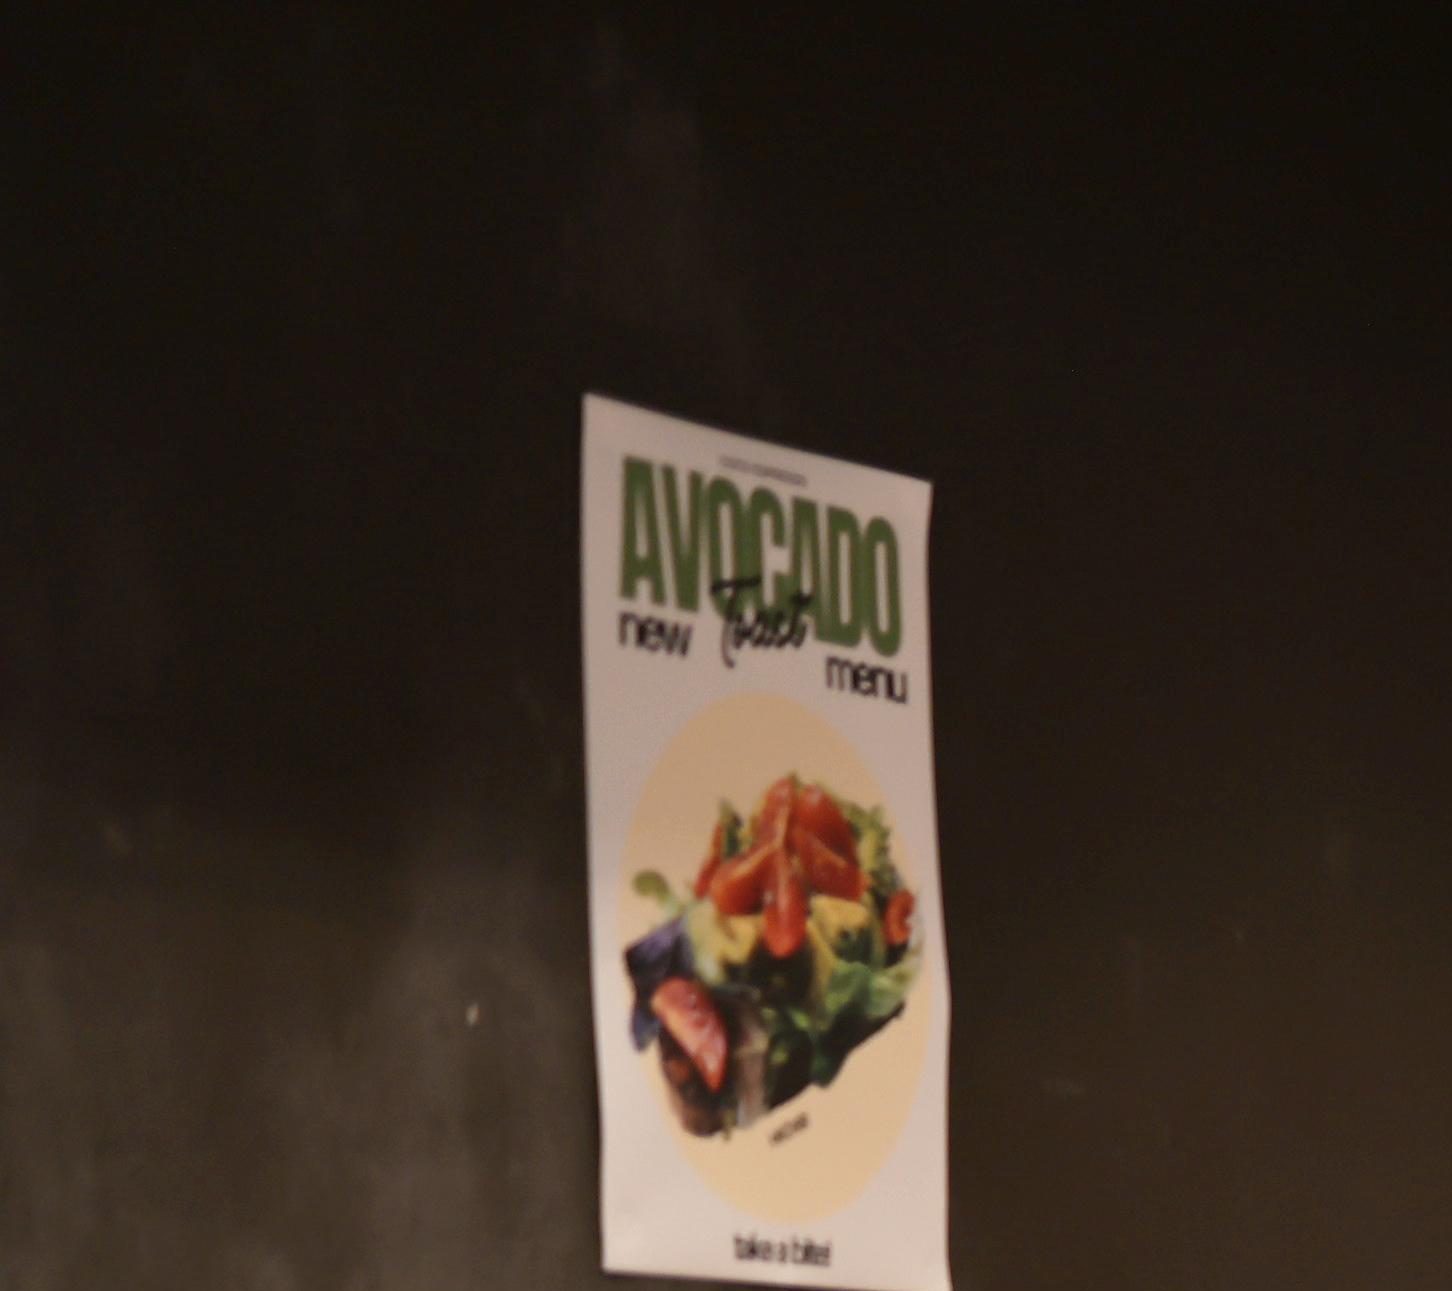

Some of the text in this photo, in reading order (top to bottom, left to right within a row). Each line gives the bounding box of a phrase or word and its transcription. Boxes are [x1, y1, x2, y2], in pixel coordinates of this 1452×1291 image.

[620, 454, 903, 658] AVOCADO
[618, 610, 693, 659] new
[825, 655, 908, 705] menu
[733, 1231, 773, 1263] take
